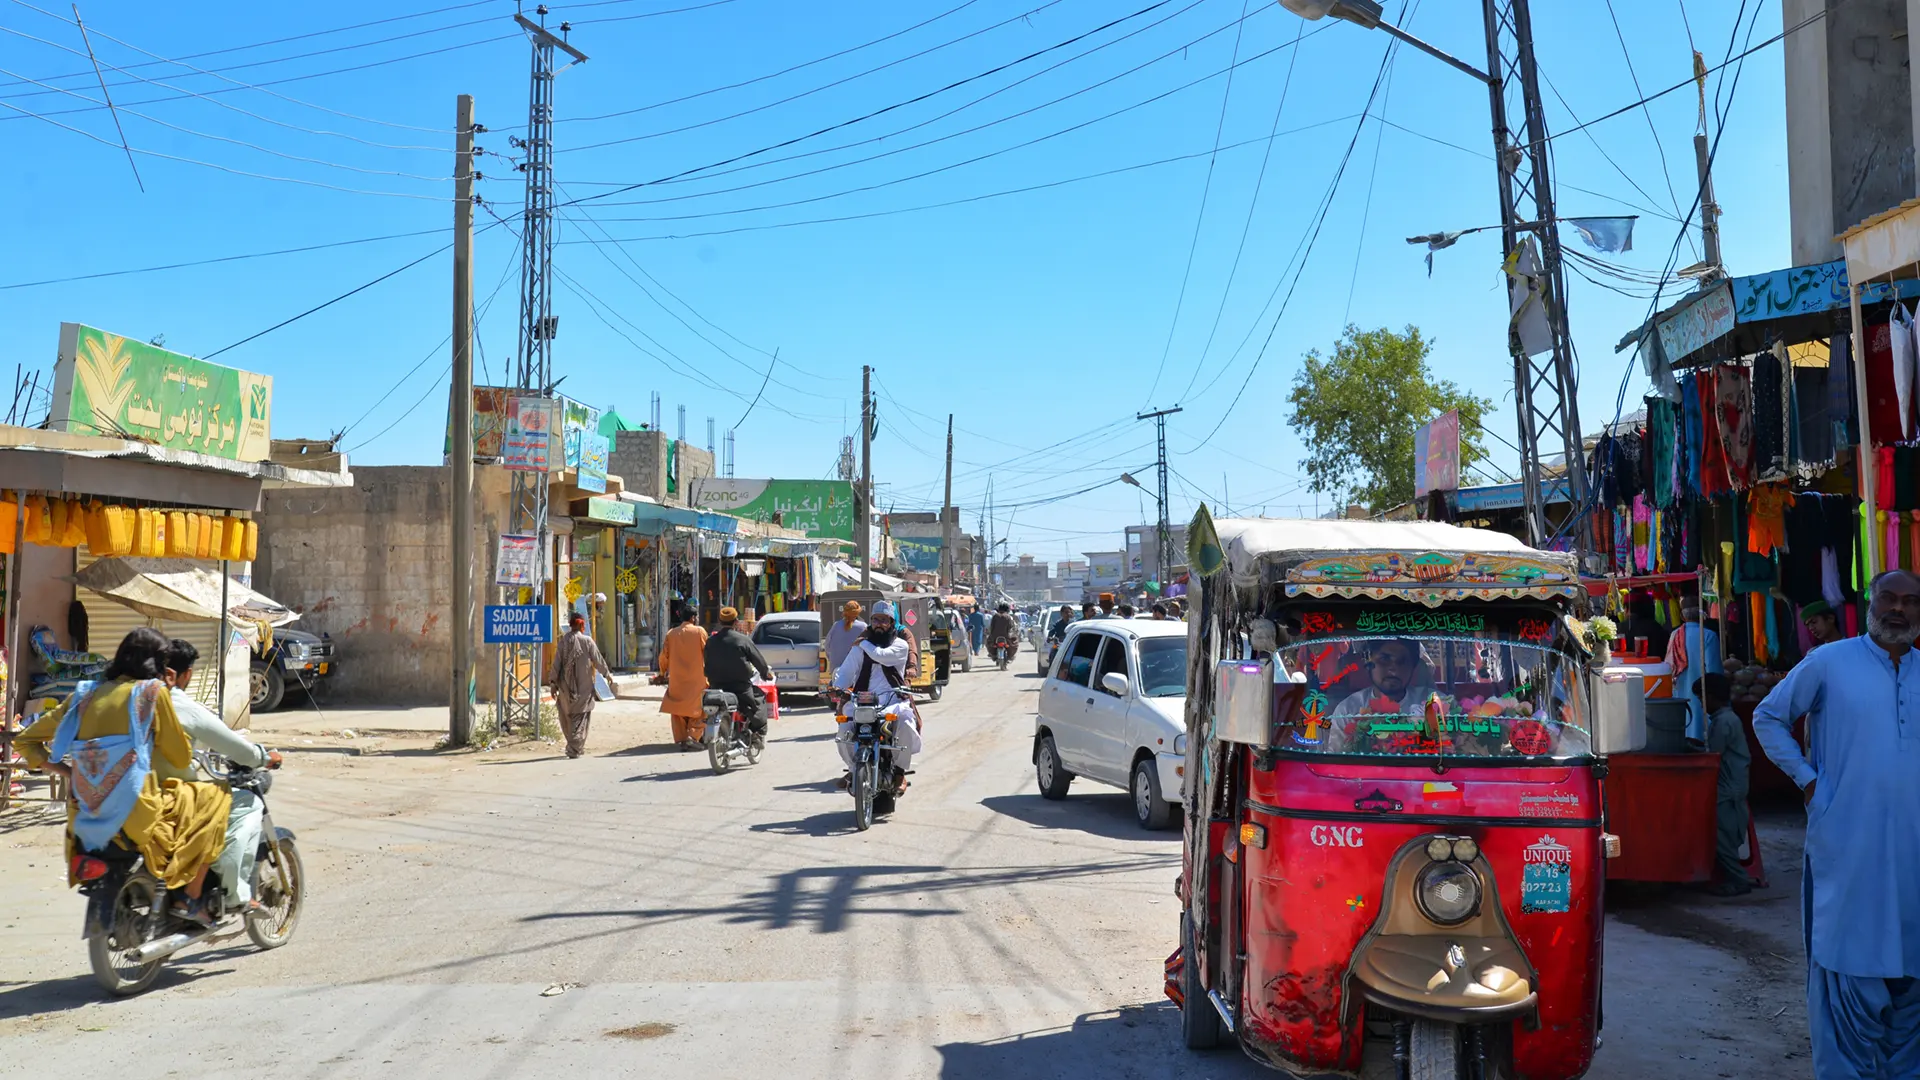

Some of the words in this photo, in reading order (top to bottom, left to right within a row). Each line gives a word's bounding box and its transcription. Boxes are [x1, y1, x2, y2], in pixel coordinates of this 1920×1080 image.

[127, 394, 162, 439] بچت
[164, 400, 203, 446] قومی
[203, 403, 235, 450] مرکز
[492, 609, 538, 622] SADDAT
[492, 624, 540, 636] MOHULA
[1523, 850, 1572, 862] UNIQUE
[1525, 882, 1562, 893] 02723
